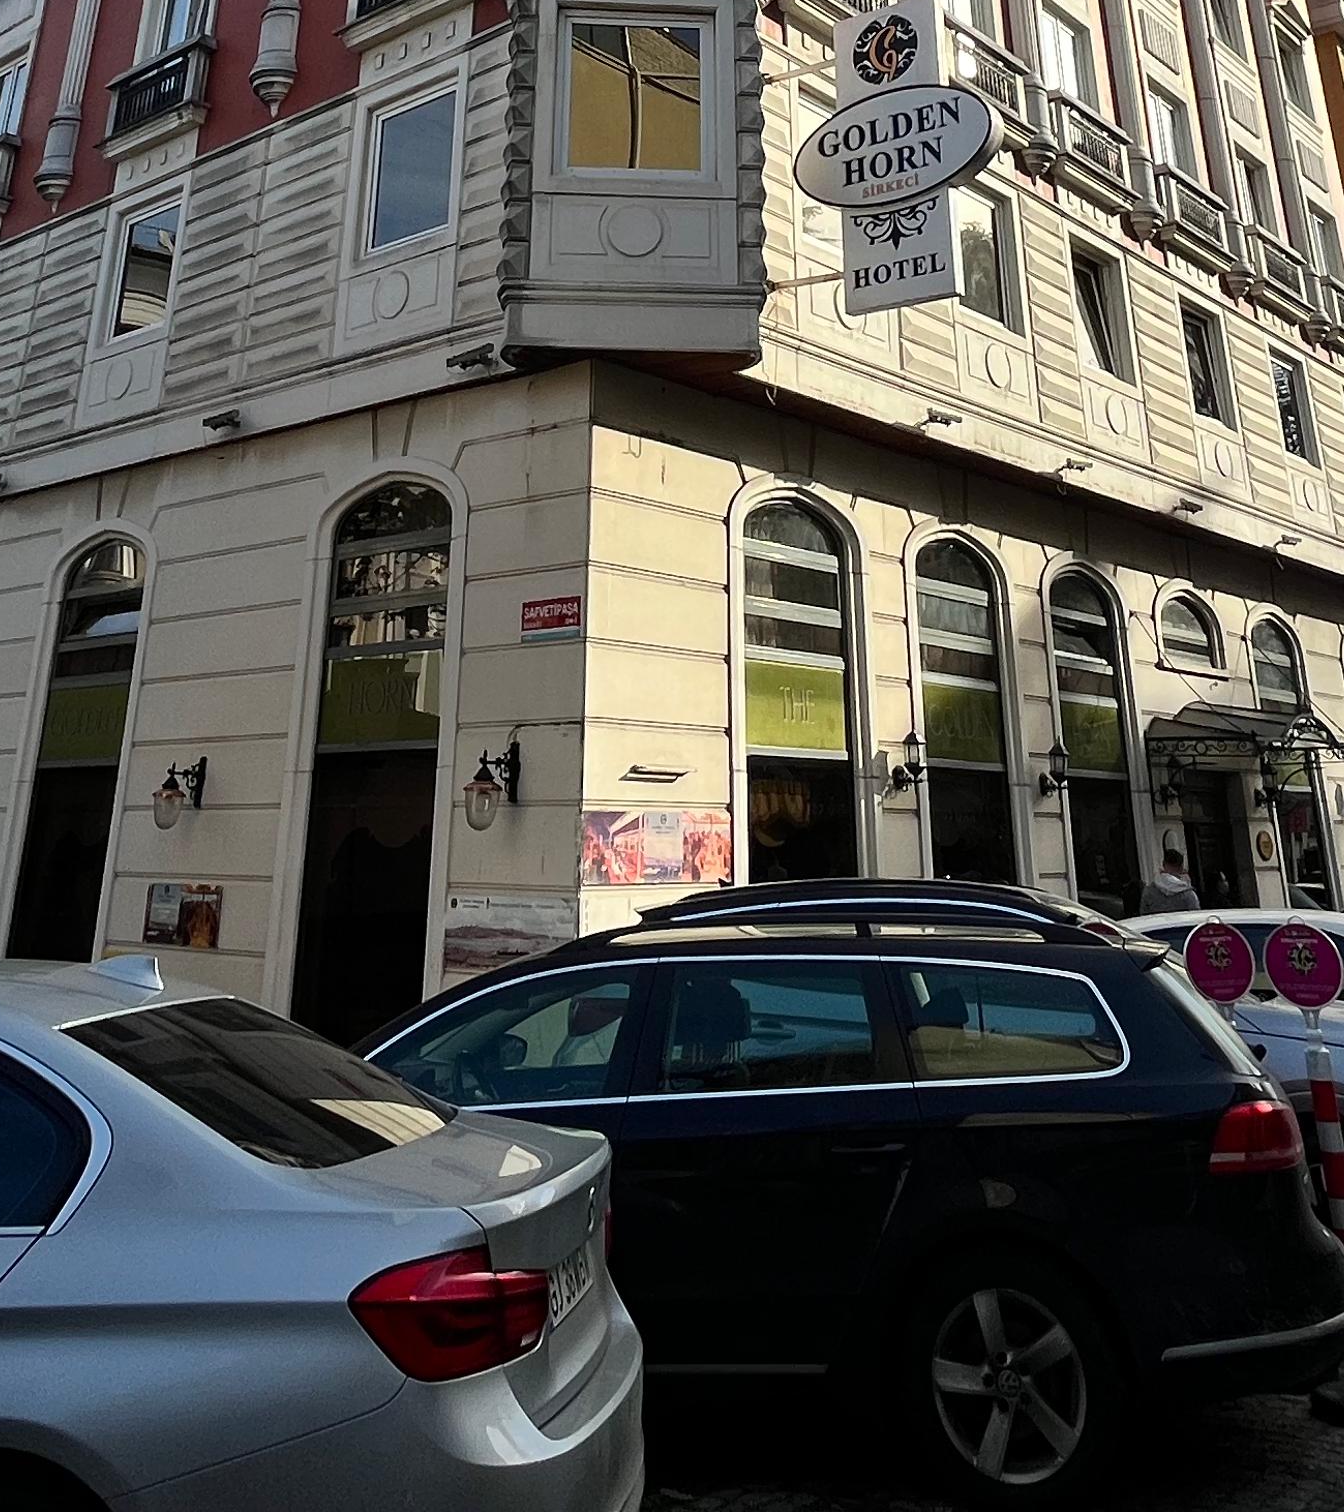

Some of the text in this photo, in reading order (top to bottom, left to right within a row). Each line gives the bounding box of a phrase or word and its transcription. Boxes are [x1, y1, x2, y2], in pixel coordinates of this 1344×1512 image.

[818, 96, 961, 158] GOLDEN
[842, 136, 944, 187] HORN
[862, 173, 920, 199] SİRKECİ
[852, 252, 946, 290] HOTEL
[779, 686, 816, 725] THE
